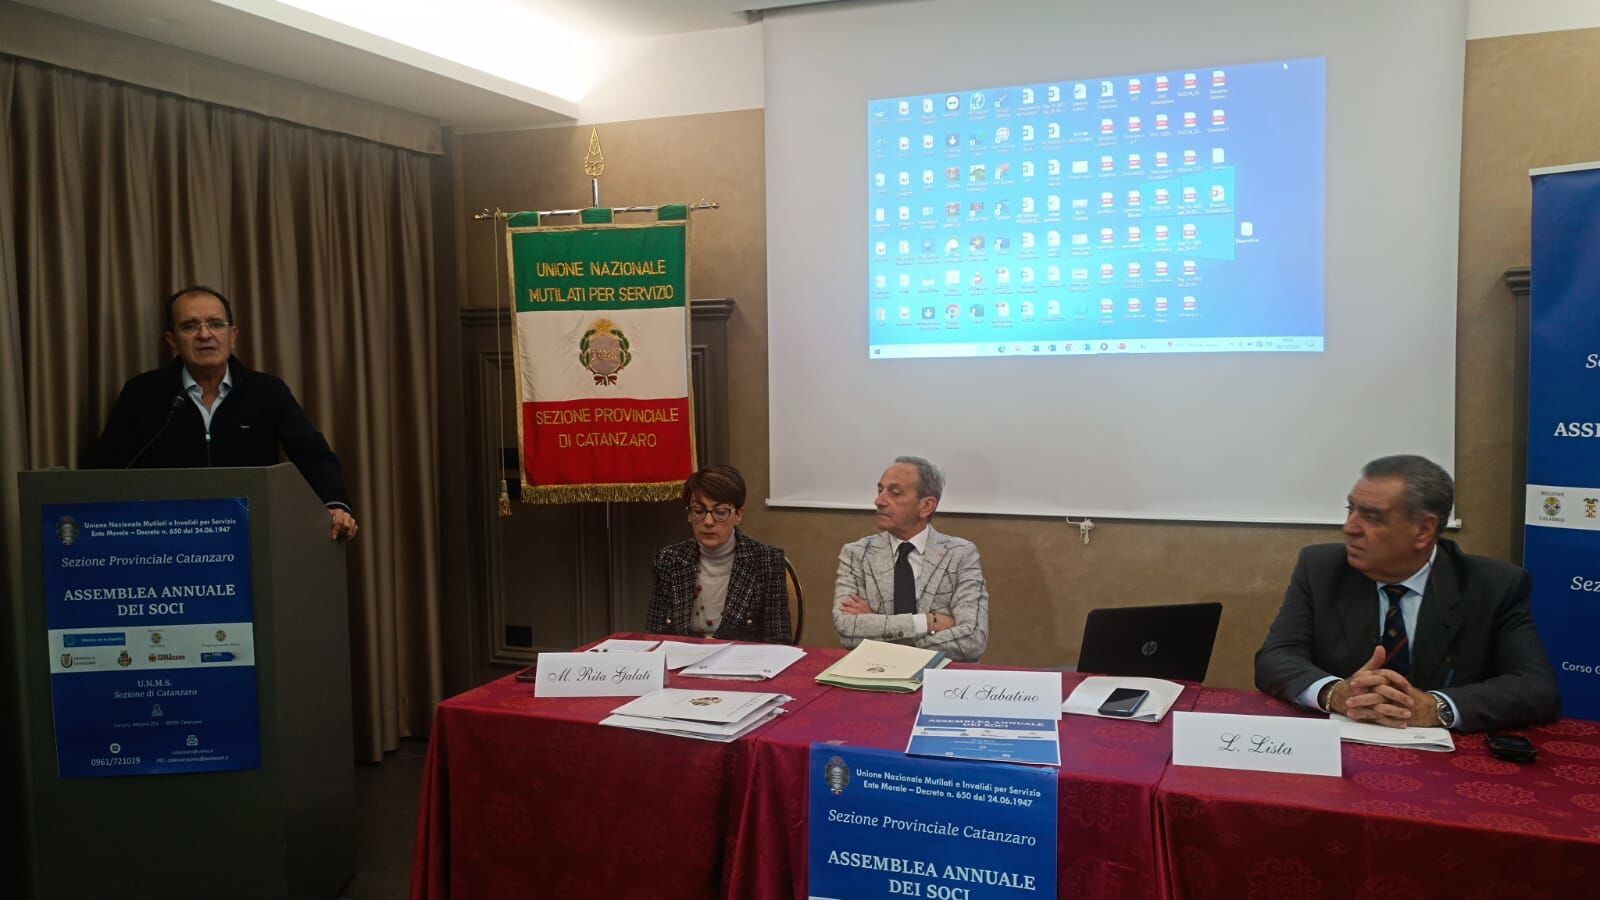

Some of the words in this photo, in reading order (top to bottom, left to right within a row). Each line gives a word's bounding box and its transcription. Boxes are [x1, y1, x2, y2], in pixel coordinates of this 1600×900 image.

[536, 262, 584, 277] UNIONE
[590, 260, 666, 276] NAZIONALE
[529, 287, 586, 303] MUTILATI
[589, 287, 614, 302] PER
[618, 284, 674, 300] SERVIZIO
[1586, 353, 1600, 368] S
[536, 409, 590, 425] SEZIONE
[594, 408, 680, 423] PROVINCIALE
[559, 434, 572, 448] DI
[576, 432, 656, 448] CATANZARO
[62, 557, 105, 568] Sezione
[108, 554, 172, 566] Provinciale
[176, 553, 235, 564] Catanzaro
[64, 587, 156, 601] ASSEMBLEA
[161, 584, 236, 598] ANNUALE
[117, 604, 144, 616] DEI
[148, 602, 184, 615] SOCI
[548, 666, 572, 682] M.
[576, 668, 607, 682] Rita
[612, 666, 651, 684] Galati
[1562, 662, 1592, 674] Corso
[137, 680, 172, 688] U.N.M.S.
[113, 690, 144, 699] Sezione
[146, 689, 154, 697] di
[157, 688, 198, 698] Catanzaro
[944, 684, 970, 700] A.
[975, 684, 1039, 702] Sabatino
[1219, 732, 1240, 752] L.
[1248, 734, 1292, 756] Lista
[91, 757, 141, 766] 0961/721019
[856, 768, 882, 779] Unione
[884, 772, 923, 784] Nazionale
[924, 776, 954, 787] Mutilati
[962, 780, 992, 792] Invalidi
[994, 786, 1007, 794] per
[1009, 786, 1041, 798] Servizio
[864, 780, 879, 790] Ente
[881, 782, 907, 793] Morale
[916, 786, 944, 797] Decreto
[956, 791, 972, 800] 650
[973, 793, 985, 802] del
[987, 795, 1032, 808] 24.06.1947
[828, 809, 879, 826] Sezione
[882, 816, 959, 836] Provinciale
[963, 825, 1036, 846] Catanzaro
[827, 850, 938, 878] ASSEMBLEA
[942, 865, 1036, 890] ANNUALE
[888, 879, 921, 896] DEI
[927, 884, 970, 900] SOCI
